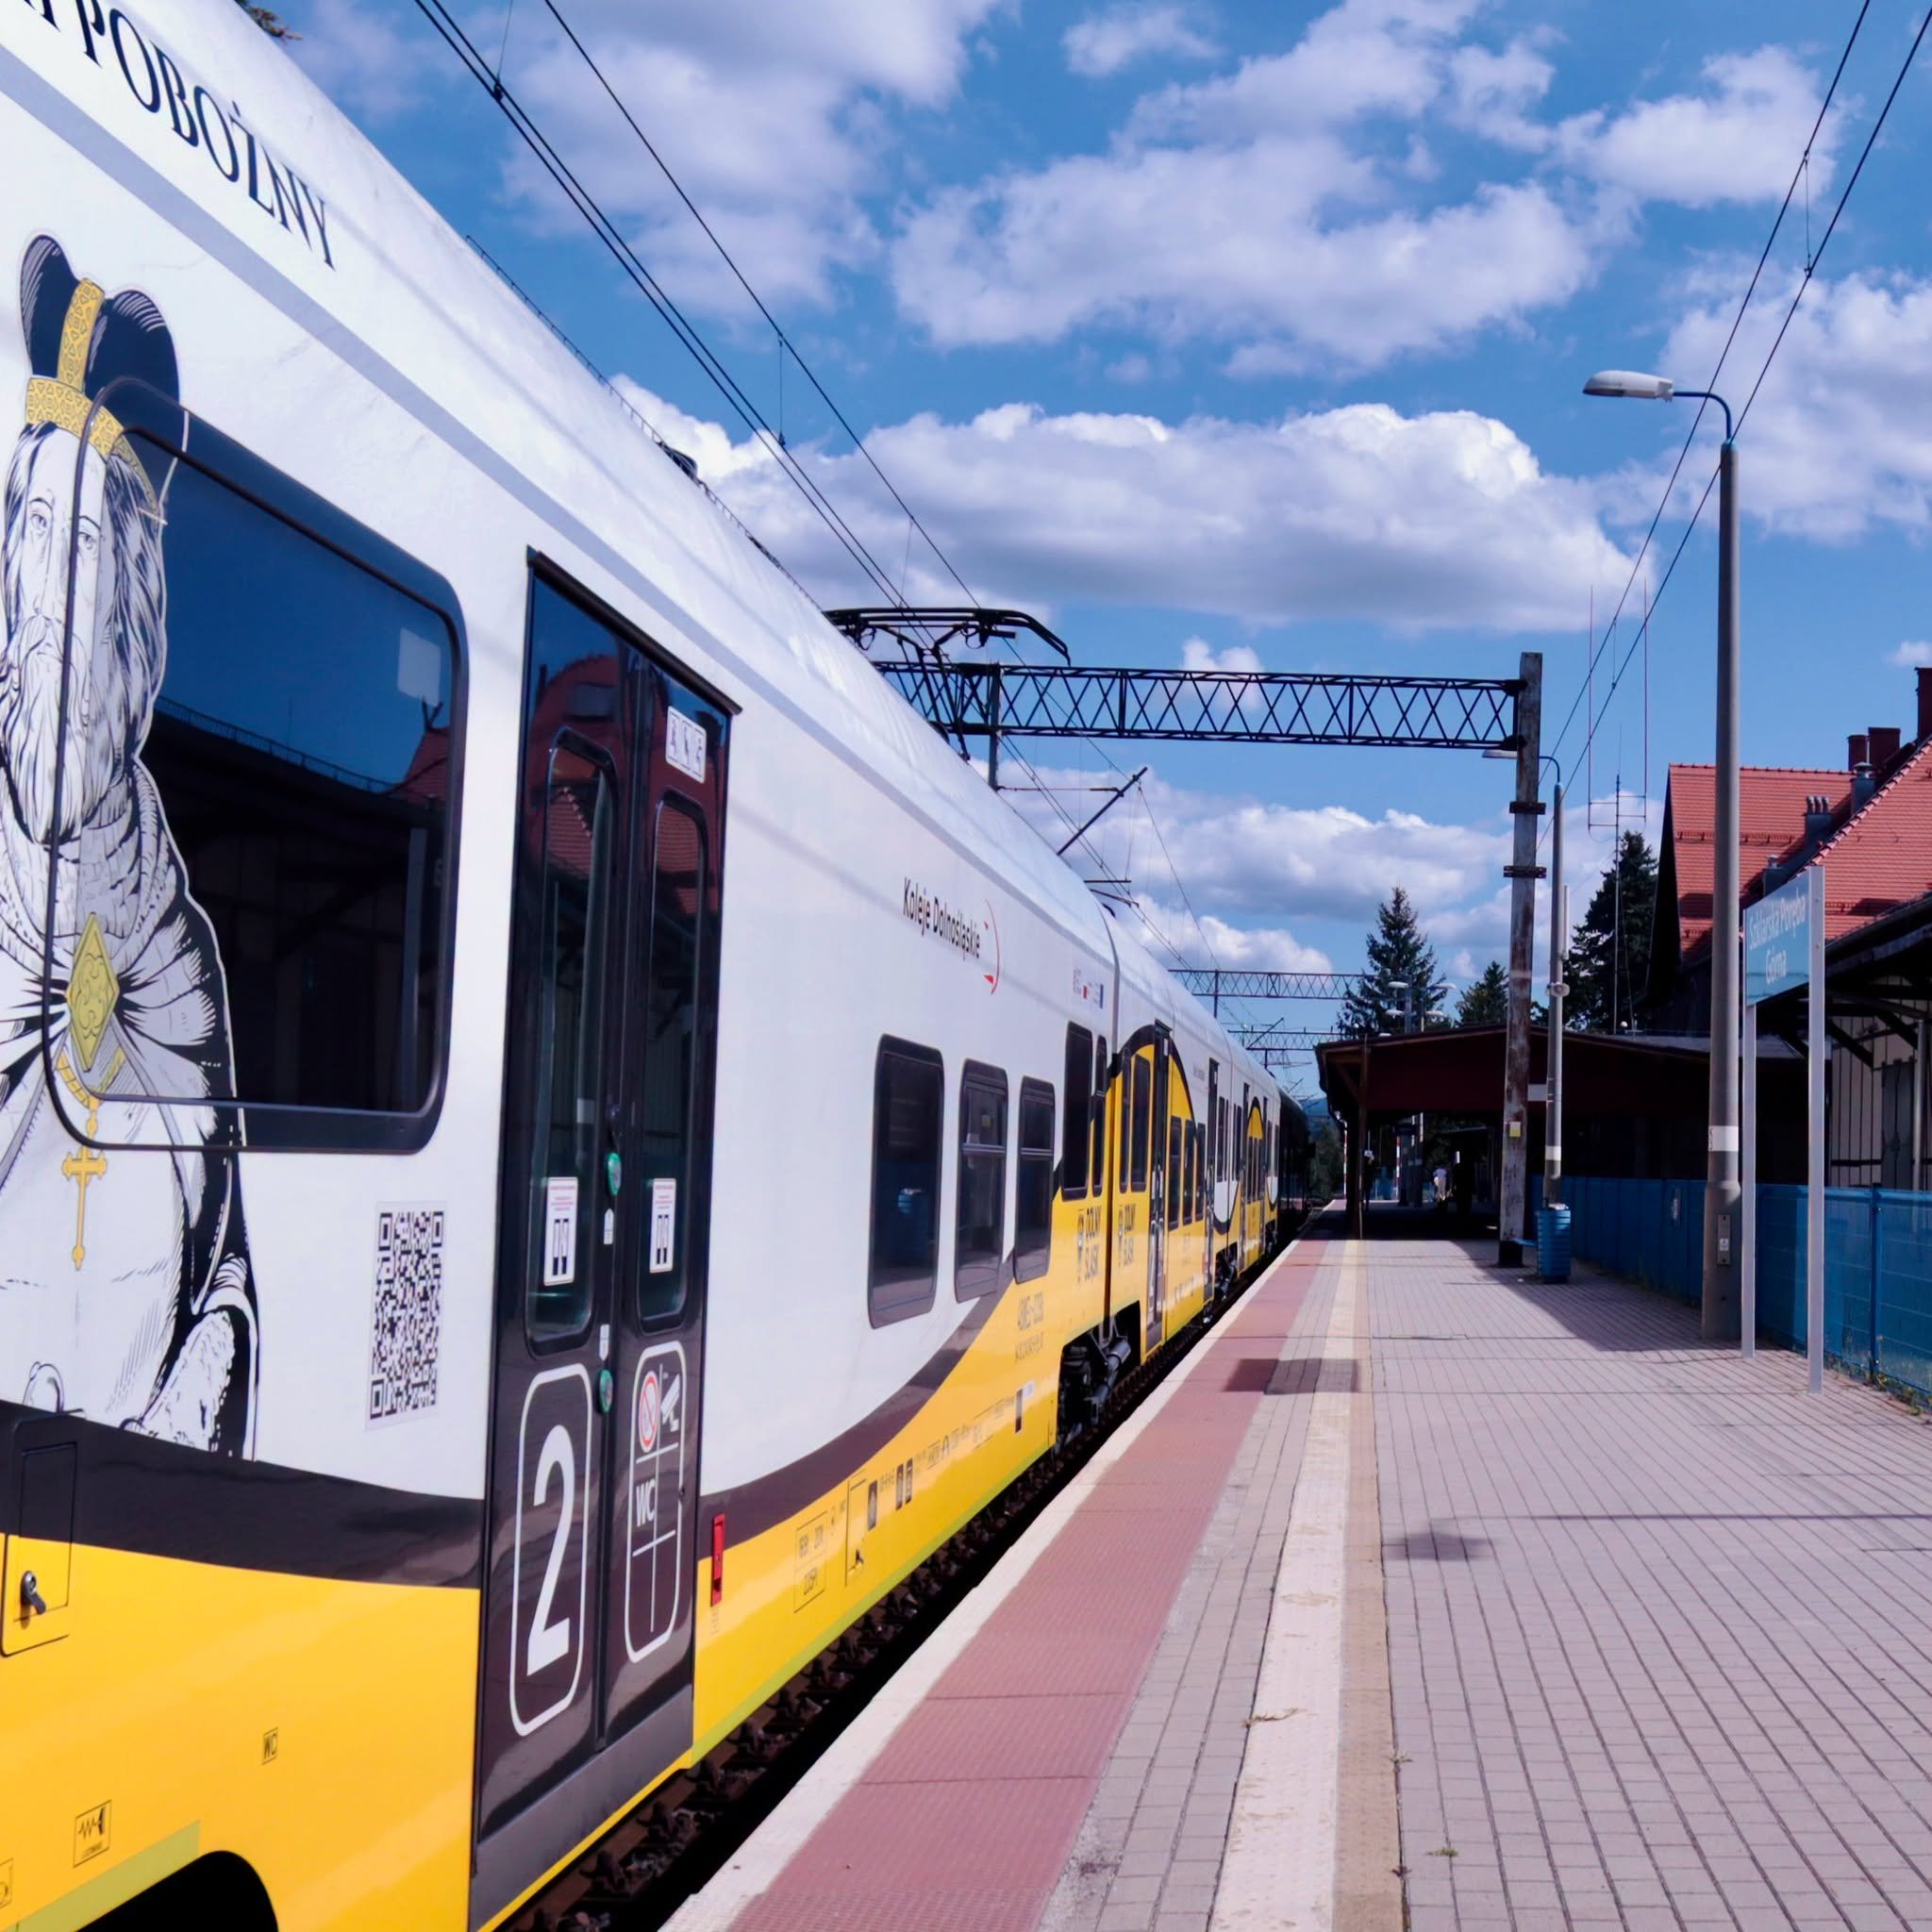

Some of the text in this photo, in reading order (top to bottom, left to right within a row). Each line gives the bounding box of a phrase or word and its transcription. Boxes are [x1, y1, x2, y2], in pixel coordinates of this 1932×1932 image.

[903, 876, 980, 961] Koleje Dolnośląskie
[635, 1478, 658, 1527] WC
[526, 1424, 575, 1676] 2
